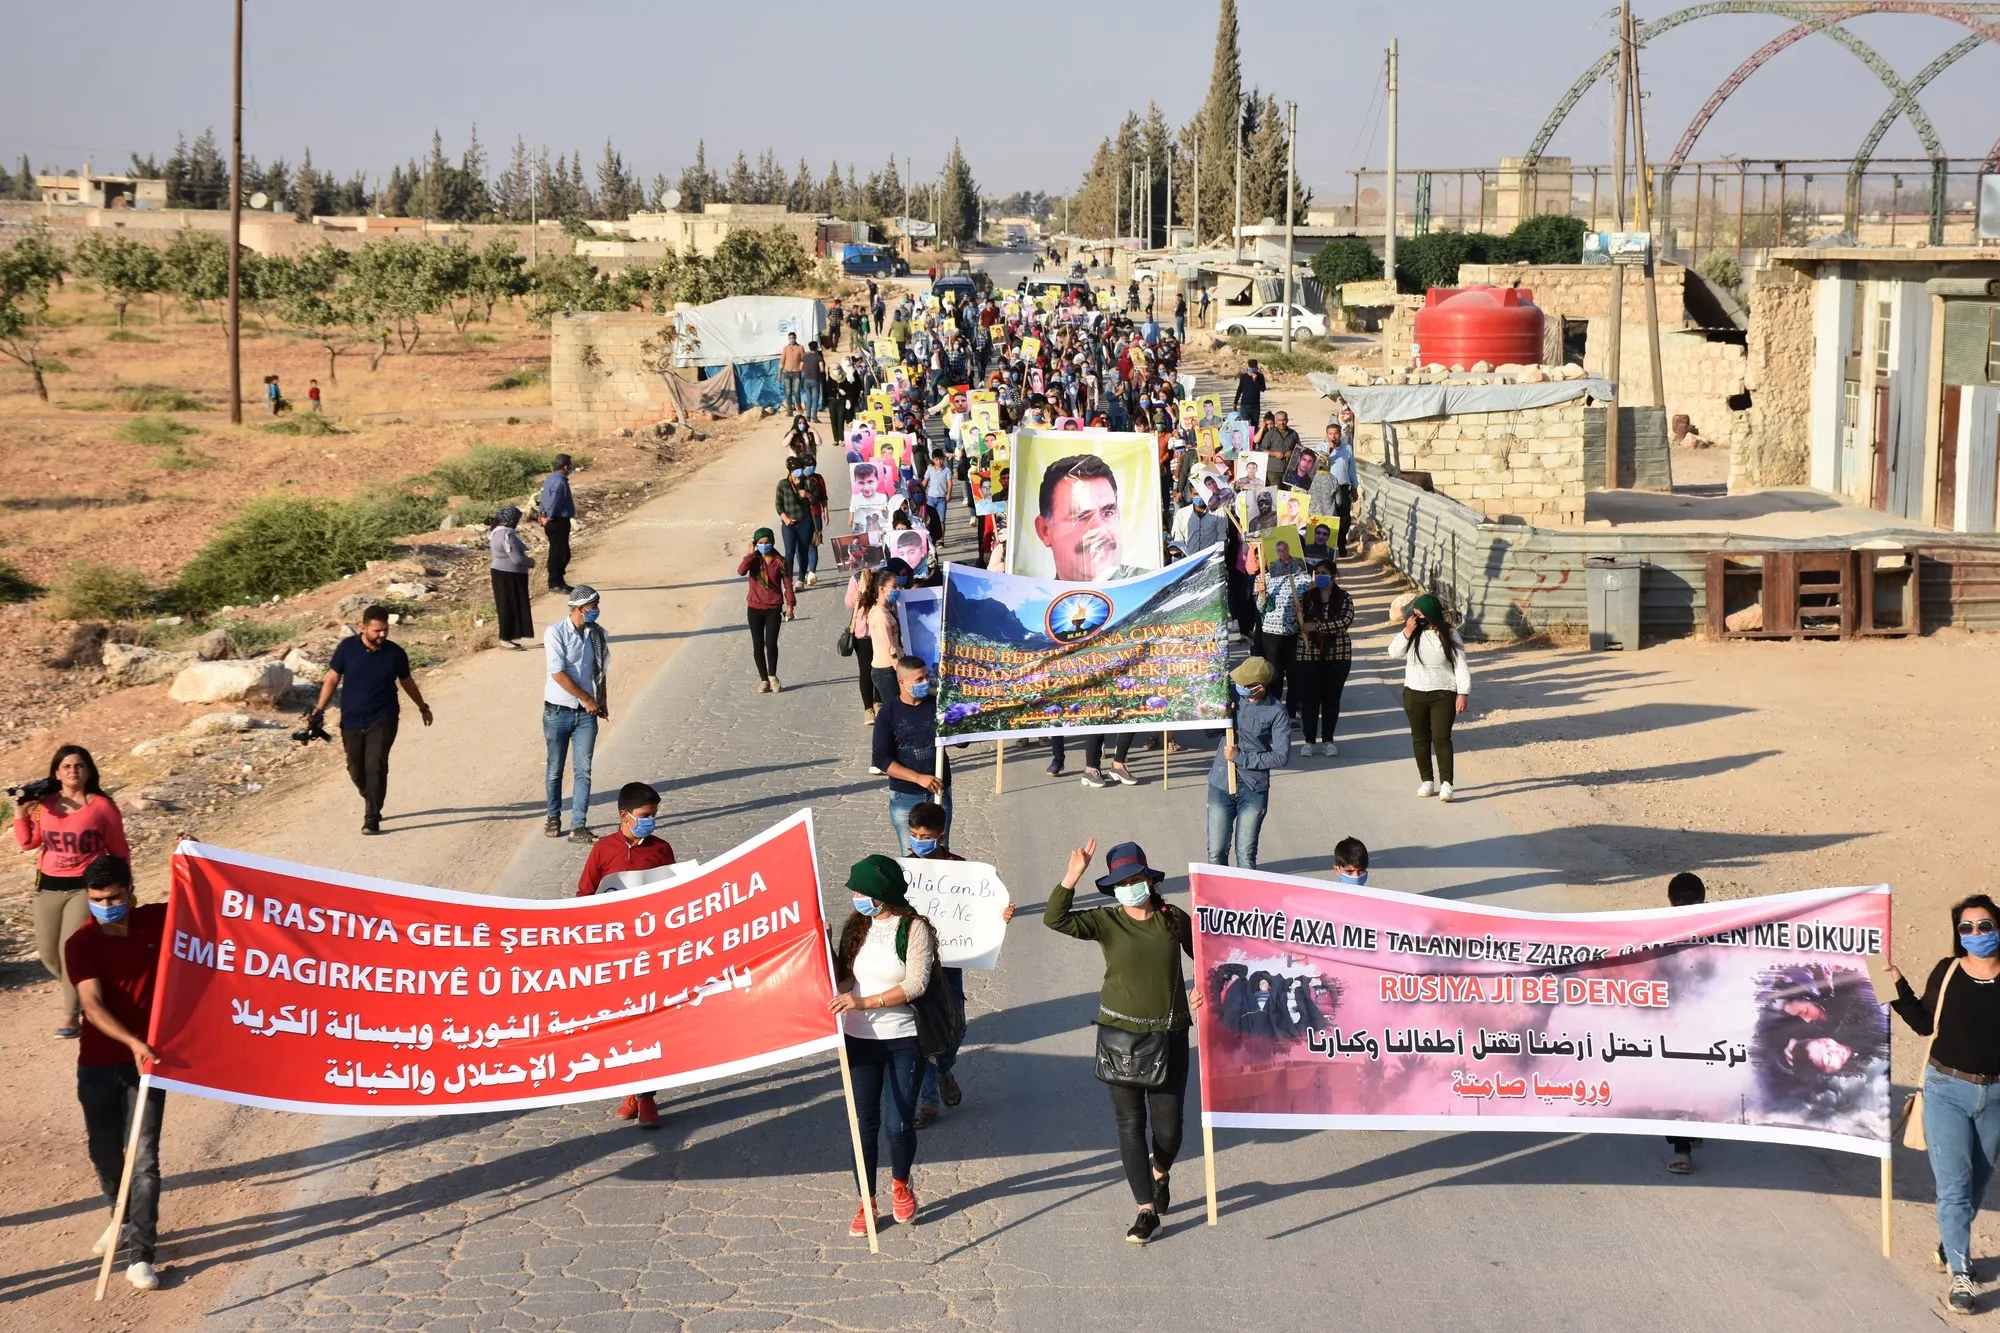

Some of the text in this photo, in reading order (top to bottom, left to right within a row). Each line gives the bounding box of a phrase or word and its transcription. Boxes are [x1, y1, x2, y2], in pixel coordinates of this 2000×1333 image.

[954, 643, 996, 662] RIHÊ
[1116, 645, 1145, 662] WÊ
[1149, 640, 1218, 658] RIZGAR
[1166, 658, 1209, 676] BIBÊ
[221, 871, 768, 954] BI RASTIYA GELÊ ŞERKER Û GERÎLA
[173, 900, 800, 996] EMÊ DAGIRKERIYÊ Û ÎXANETÊ TÊK BIBIN
[1289, 918, 1337, 946] AXA
[1342, 924, 1377, 950] ME
[1385, 930, 1462, 958] TALAN
[1754, 922, 1790, 948] ME
[1521, 972, 1559, 1003] BÊ
[1564, 977, 1669, 1007] DENGE
[230, 964, 753, 1051] بالحرب الشعبية الثورية وببسالة الكريلا
[1307, 1028, 1379, 1060] وكبارنا
[1385, 1029, 1464, 1056] أطفالنا
[1472, 1029, 1522, 1060] تقتل
[1527, 1029, 1593, 1062] أرضنا
[1601, 1032, 1653, 1063] تحتل
[324, 1059, 436, 1095] والخيانة
[443, 1052, 555, 1094] الإحتلال
[1451, 1070, 1613, 1105] وروسيا صامتة
